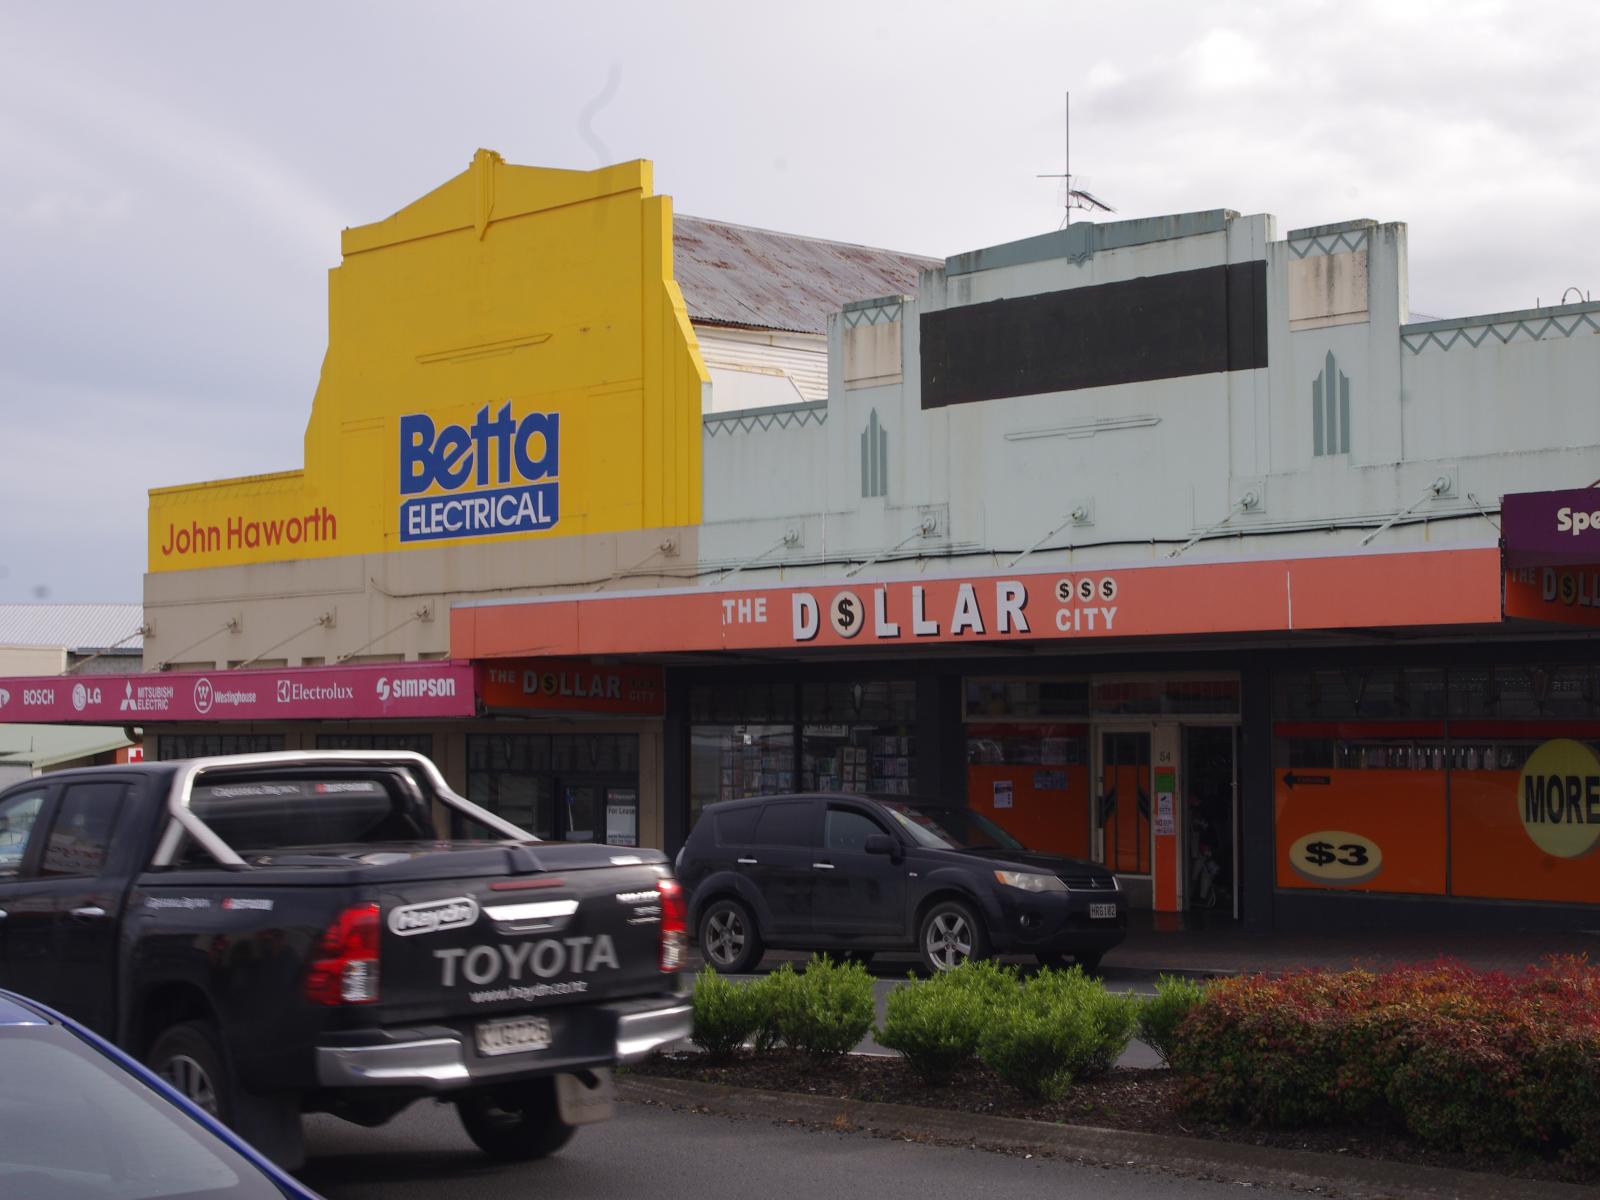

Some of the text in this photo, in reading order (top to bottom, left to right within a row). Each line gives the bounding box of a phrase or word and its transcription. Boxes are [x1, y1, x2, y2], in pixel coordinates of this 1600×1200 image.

[400, 400, 560, 495] Betta
[408, 491, 551, 534] ELECTRICAL
[162, 507, 337, 556] John Haworth
[722, 598, 767, 624] THE
[1056, 607, 1117, 632] CITY
[488, 670, 516, 684] THE
[23, 689, 55, 705] BOSCH
[87, 688, 102, 704] LG
[137, 686, 174, 698] MITSUBISHI
[214, 691, 257, 706] Westinghouse
[292, 682, 354, 700] Electrolux
[137, 698, 169, 711] ELECTRIC
[1524, 774, 1600, 825] MORE
[1304, 841, 1370, 867] $3
[433, 935, 619, 986] TOYOTA
